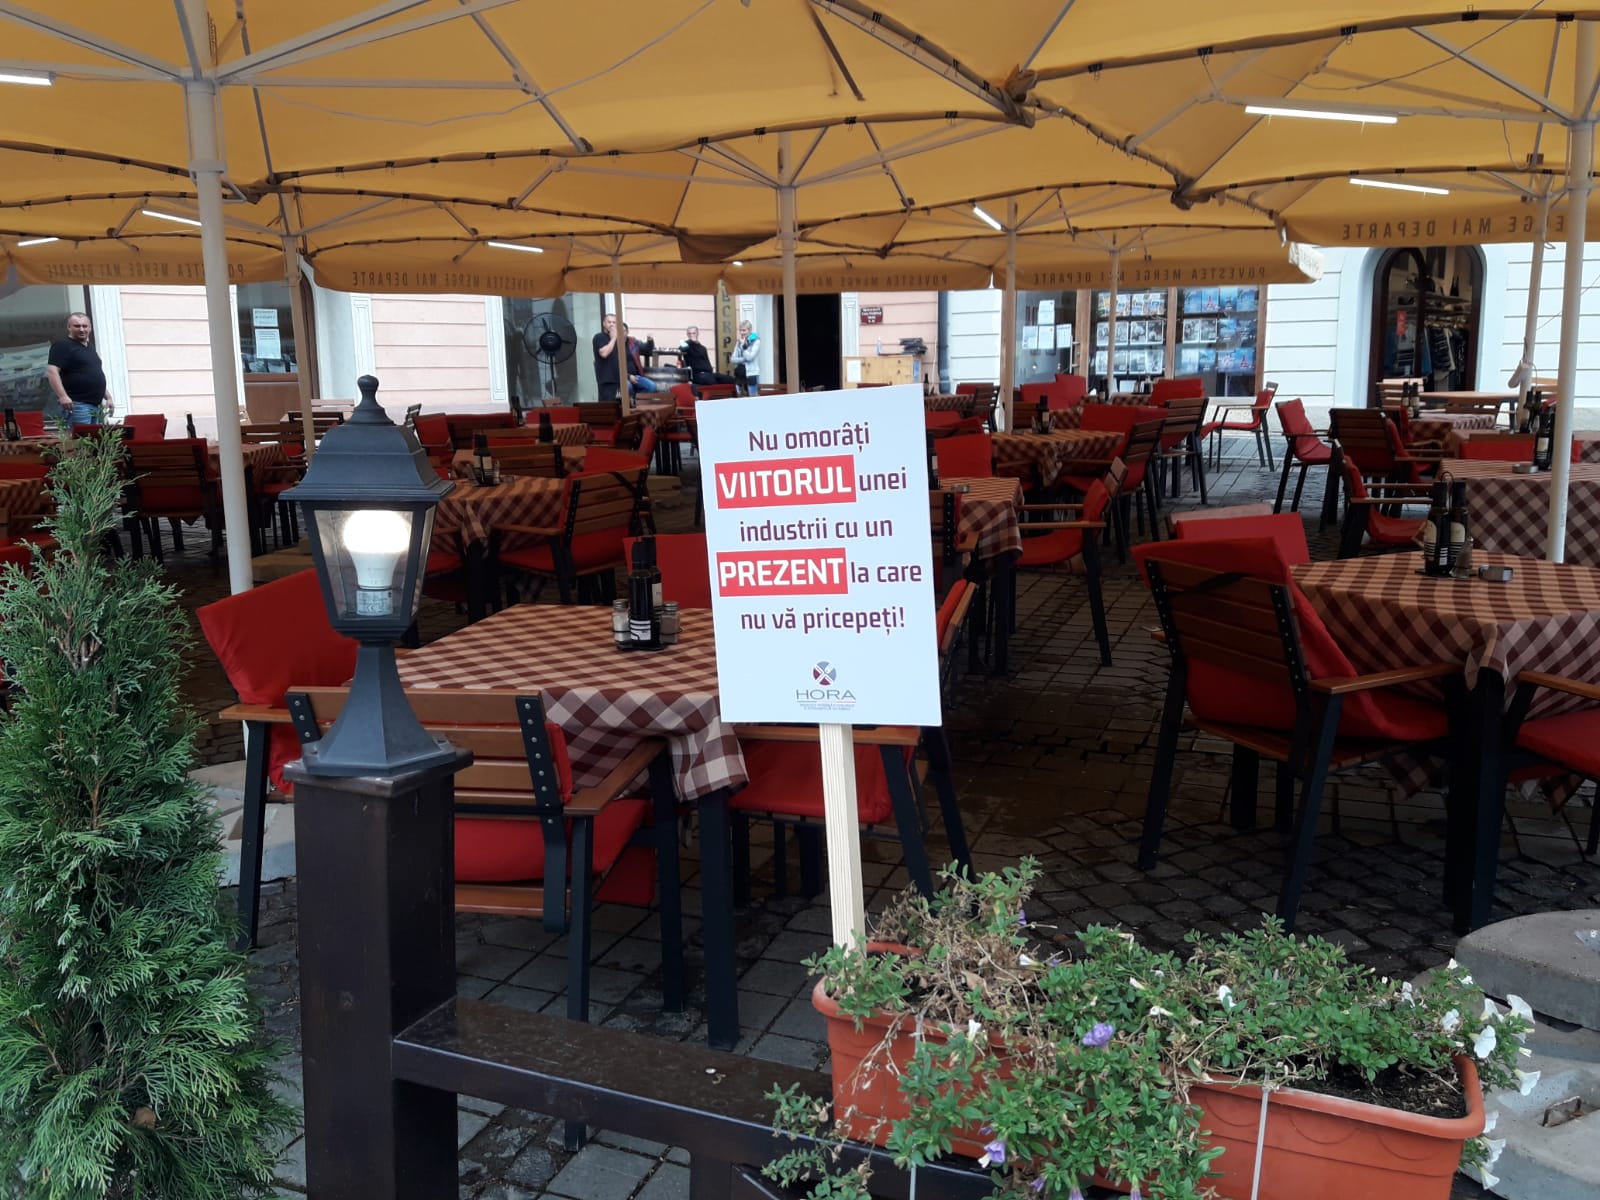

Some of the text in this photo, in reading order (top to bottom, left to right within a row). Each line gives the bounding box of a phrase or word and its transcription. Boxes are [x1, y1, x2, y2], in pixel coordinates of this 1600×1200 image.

[749, 422, 870, 452] Nu omorâți
[719, 465, 907, 499] VIITORUL unei
[740, 517, 893, 542] industrii cu un
[719, 557, 922, 587] PREZENT la care
[741, 606, 905, 636] nu vă pricepeți!
[796, 689, 857, 700] HORA
